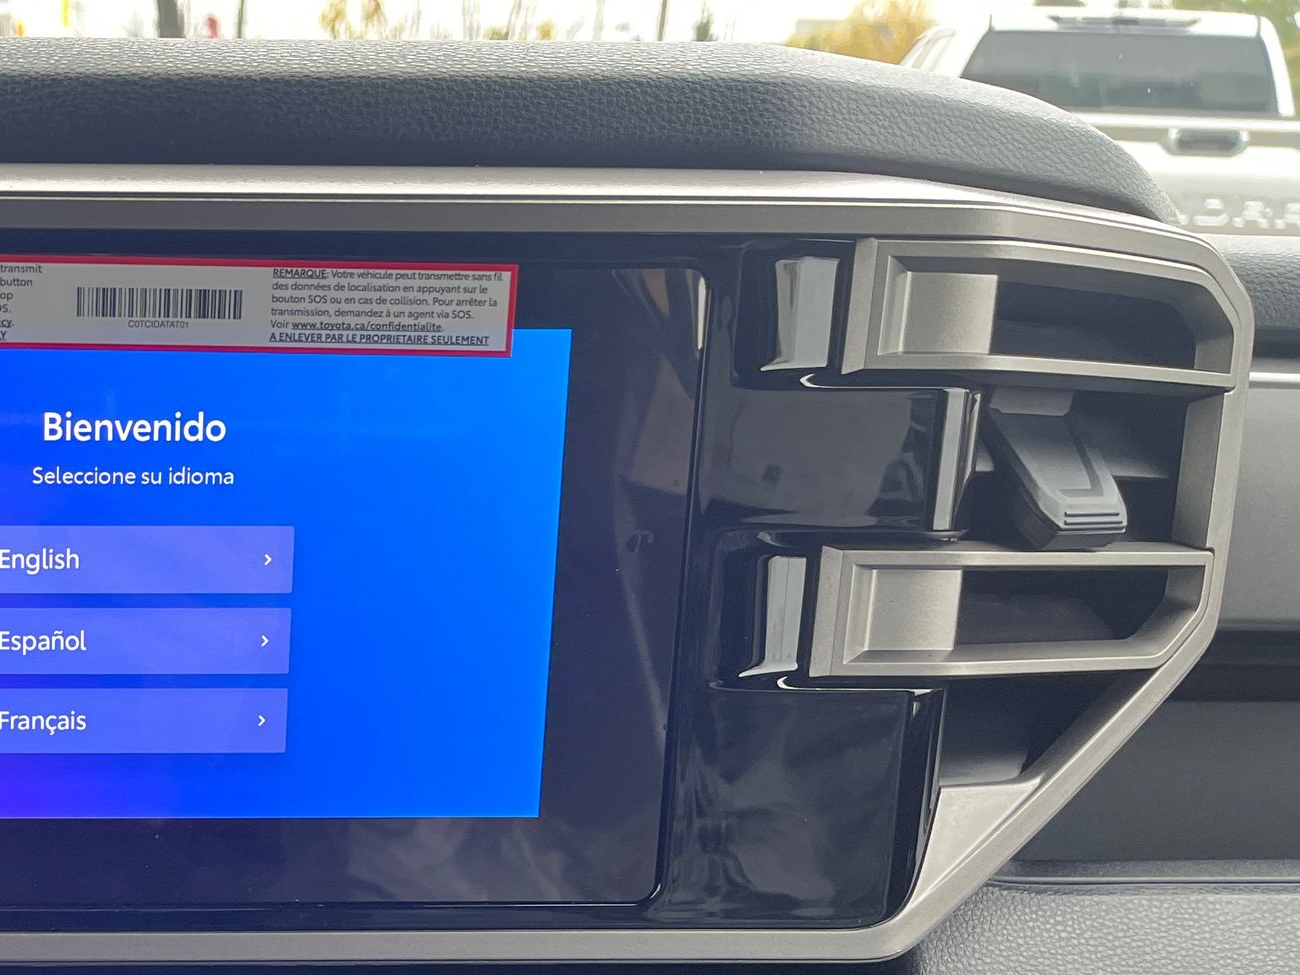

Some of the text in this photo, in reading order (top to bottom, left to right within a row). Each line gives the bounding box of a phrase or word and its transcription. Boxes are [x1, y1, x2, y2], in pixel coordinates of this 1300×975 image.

[0, 264, 42, 273] transmit
[272, 269, 329, 279] REMARQUE:
[331, 270, 354, 279] Votre
[356, 270, 393, 280] véhicule
[395, 272, 416, 281] peut
[418, 272, 470, 281] transmettre
[494, 272, 502, 281] fil
[0, 277, 33, 286] button
[272, 281, 289, 290] des
[291, 281, 331, 291] données
[333, 282, 345, 291] de
[347, 282, 400, 292] localisation
[402, 285, 414, 293] en
[416, 285, 461, 295] appuyant
[479, 285, 488, 294] le
[271, 294, 306, 303] bouton
[308, 295, 327, 304] SOS
[375, 296, 387, 305] de
[389, 296, 430, 306] collision.
[433, 297, 453, 306] Pour
[456, 297, 487, 306] arrêter
[489, 298, 497, 307] la
[271, 307, 332, 318] transmission,
[334, 308, 383, 317] demandez
[385, 309, 391, 318] à
[407, 311, 434, 320] agent
[451, 310, 473, 319] SOS.
[270, 320, 290, 328] Voir
[269, 332, 489, 346] A ENLEVER PAR LE PROPRIETAIRE SEULEMENT
[43, 411, 227, 442] Bienvenido
[32, 466, 235, 486] Seleccione su idioma
